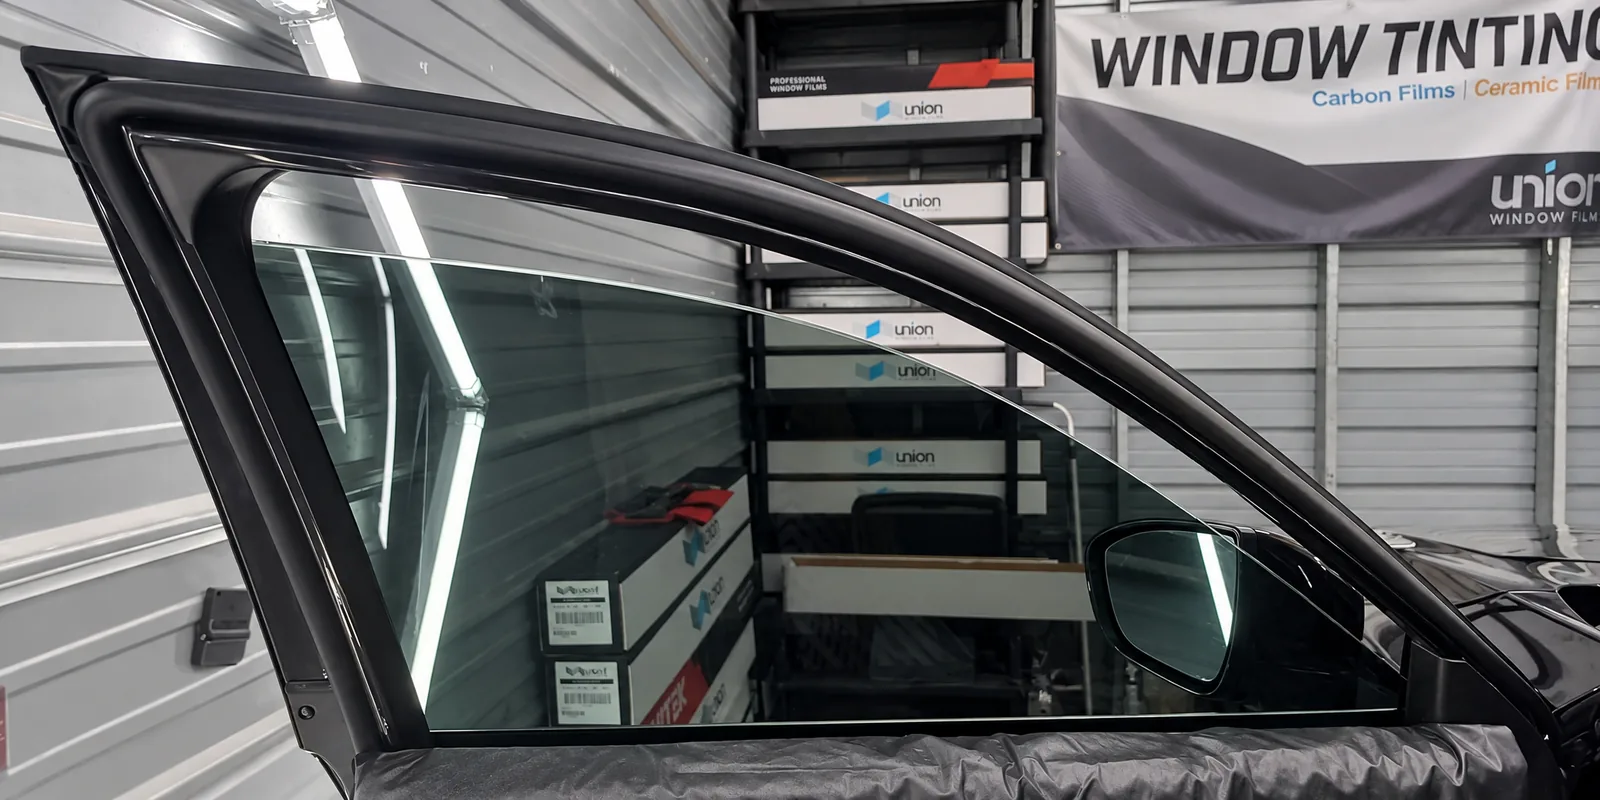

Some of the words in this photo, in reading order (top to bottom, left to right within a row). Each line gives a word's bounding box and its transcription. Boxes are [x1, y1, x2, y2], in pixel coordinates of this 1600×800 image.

[1090, 23, 1370, 89] WINDOW
[770, 76, 826, 85] PROFESSIONAL
[770, 84, 803, 93] WINDOW
[804, 83, 828, 91] FILMS
[1312, 88, 1391, 107] Carbon
[1399, 84, 1455, 101] Films
[1474, 76, 1558, 97] Ceramic
[904, 101, 943, 116] union
[903, 193, 941, 208] union
[1489, 211, 1565, 226] WINDOW
[1571, 210, 1600, 223] FILM
[895, 321, 934, 336] union
[897, 365, 936, 377] union
[896, 449, 935, 463] union
